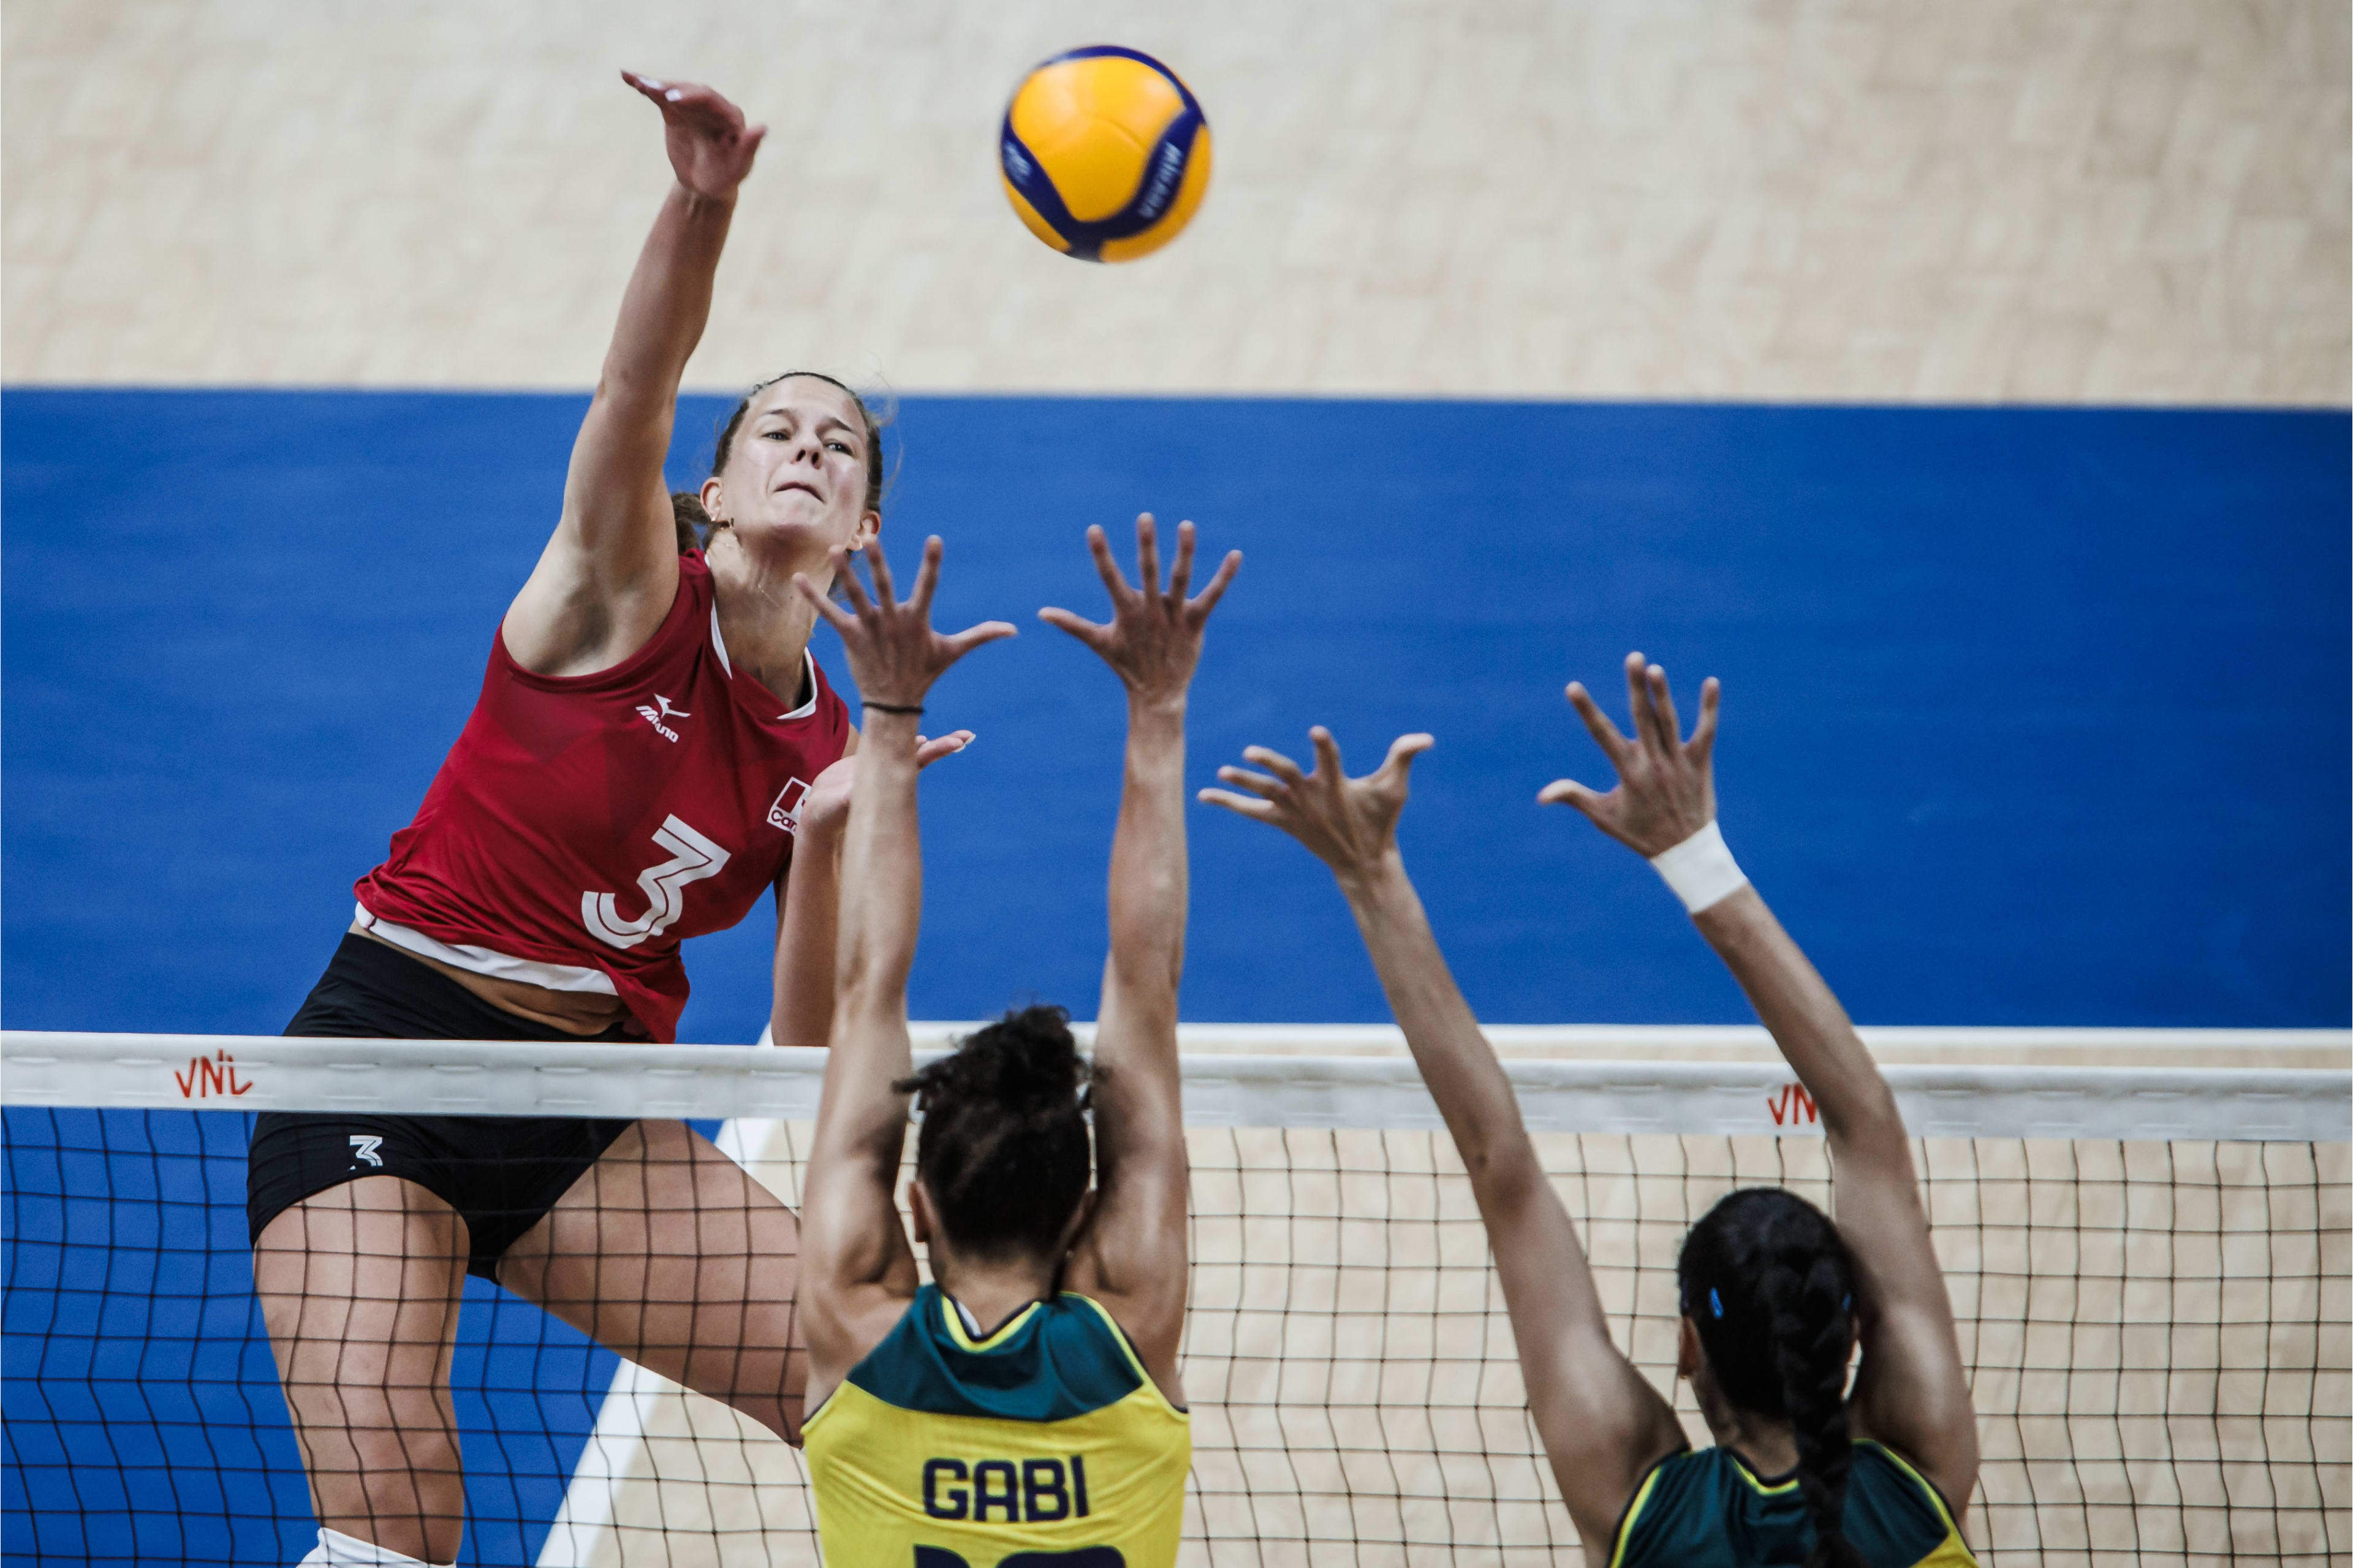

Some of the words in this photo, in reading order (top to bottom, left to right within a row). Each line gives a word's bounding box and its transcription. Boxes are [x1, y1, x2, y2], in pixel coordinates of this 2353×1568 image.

[635, 705, 679, 743] MIUNO
[581, 813, 732, 949] 3
[175, 1049, 252, 1099] VNL
[922, 1454, 1089, 1523] GABI
